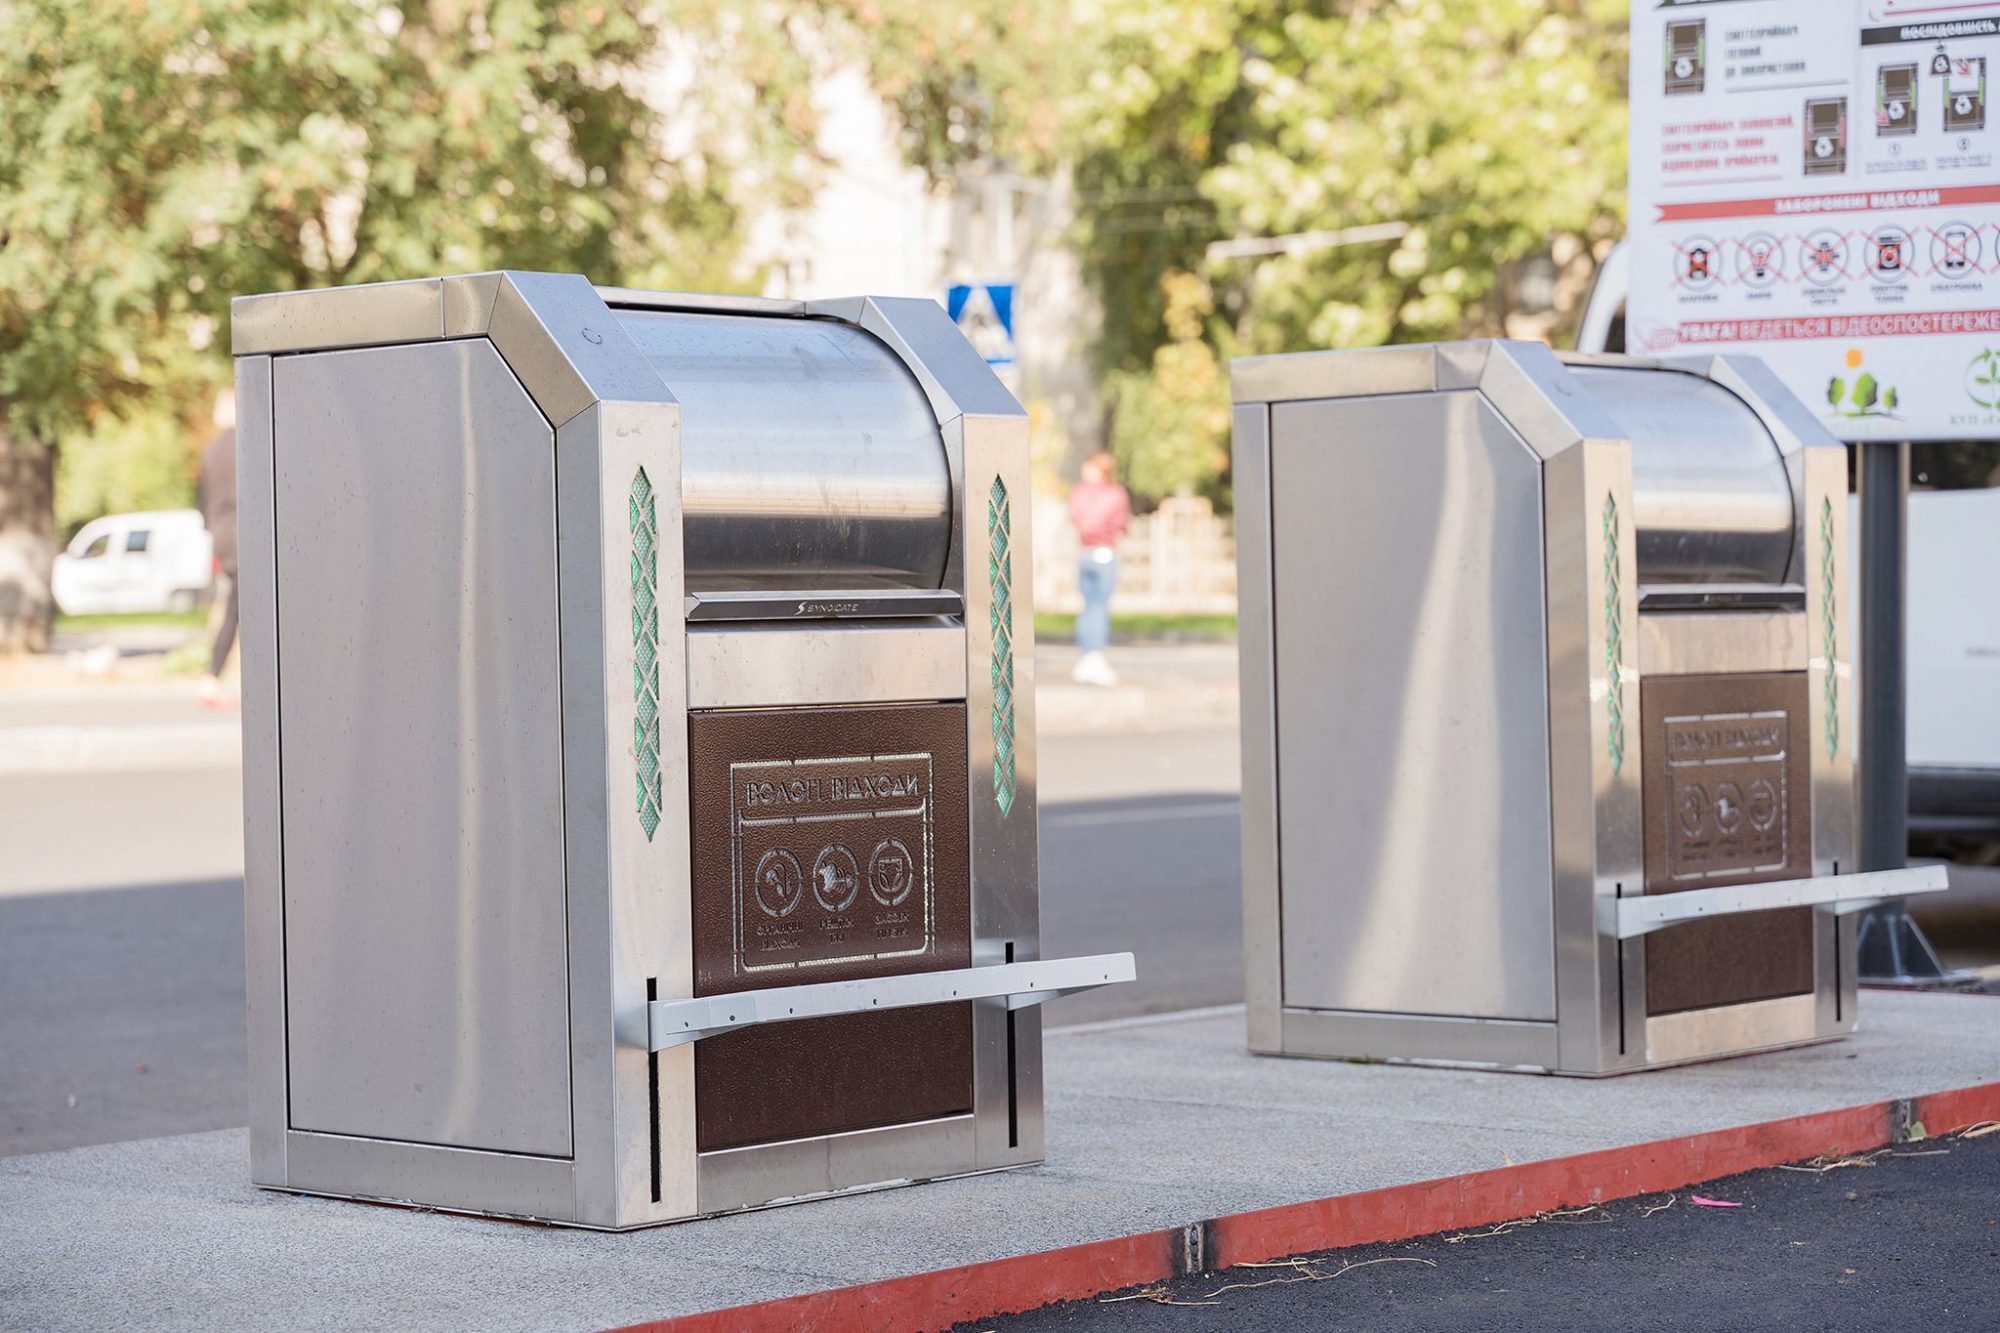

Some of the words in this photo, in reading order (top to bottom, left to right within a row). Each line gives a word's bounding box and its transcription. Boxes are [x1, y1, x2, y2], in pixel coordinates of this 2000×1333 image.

[1741, 318, 1829, 339] ВЕДЕТЬСЯ
[807, 603, 859, 613] SYNDICATE
[831, 774, 919, 801] ВІДХОДИ
